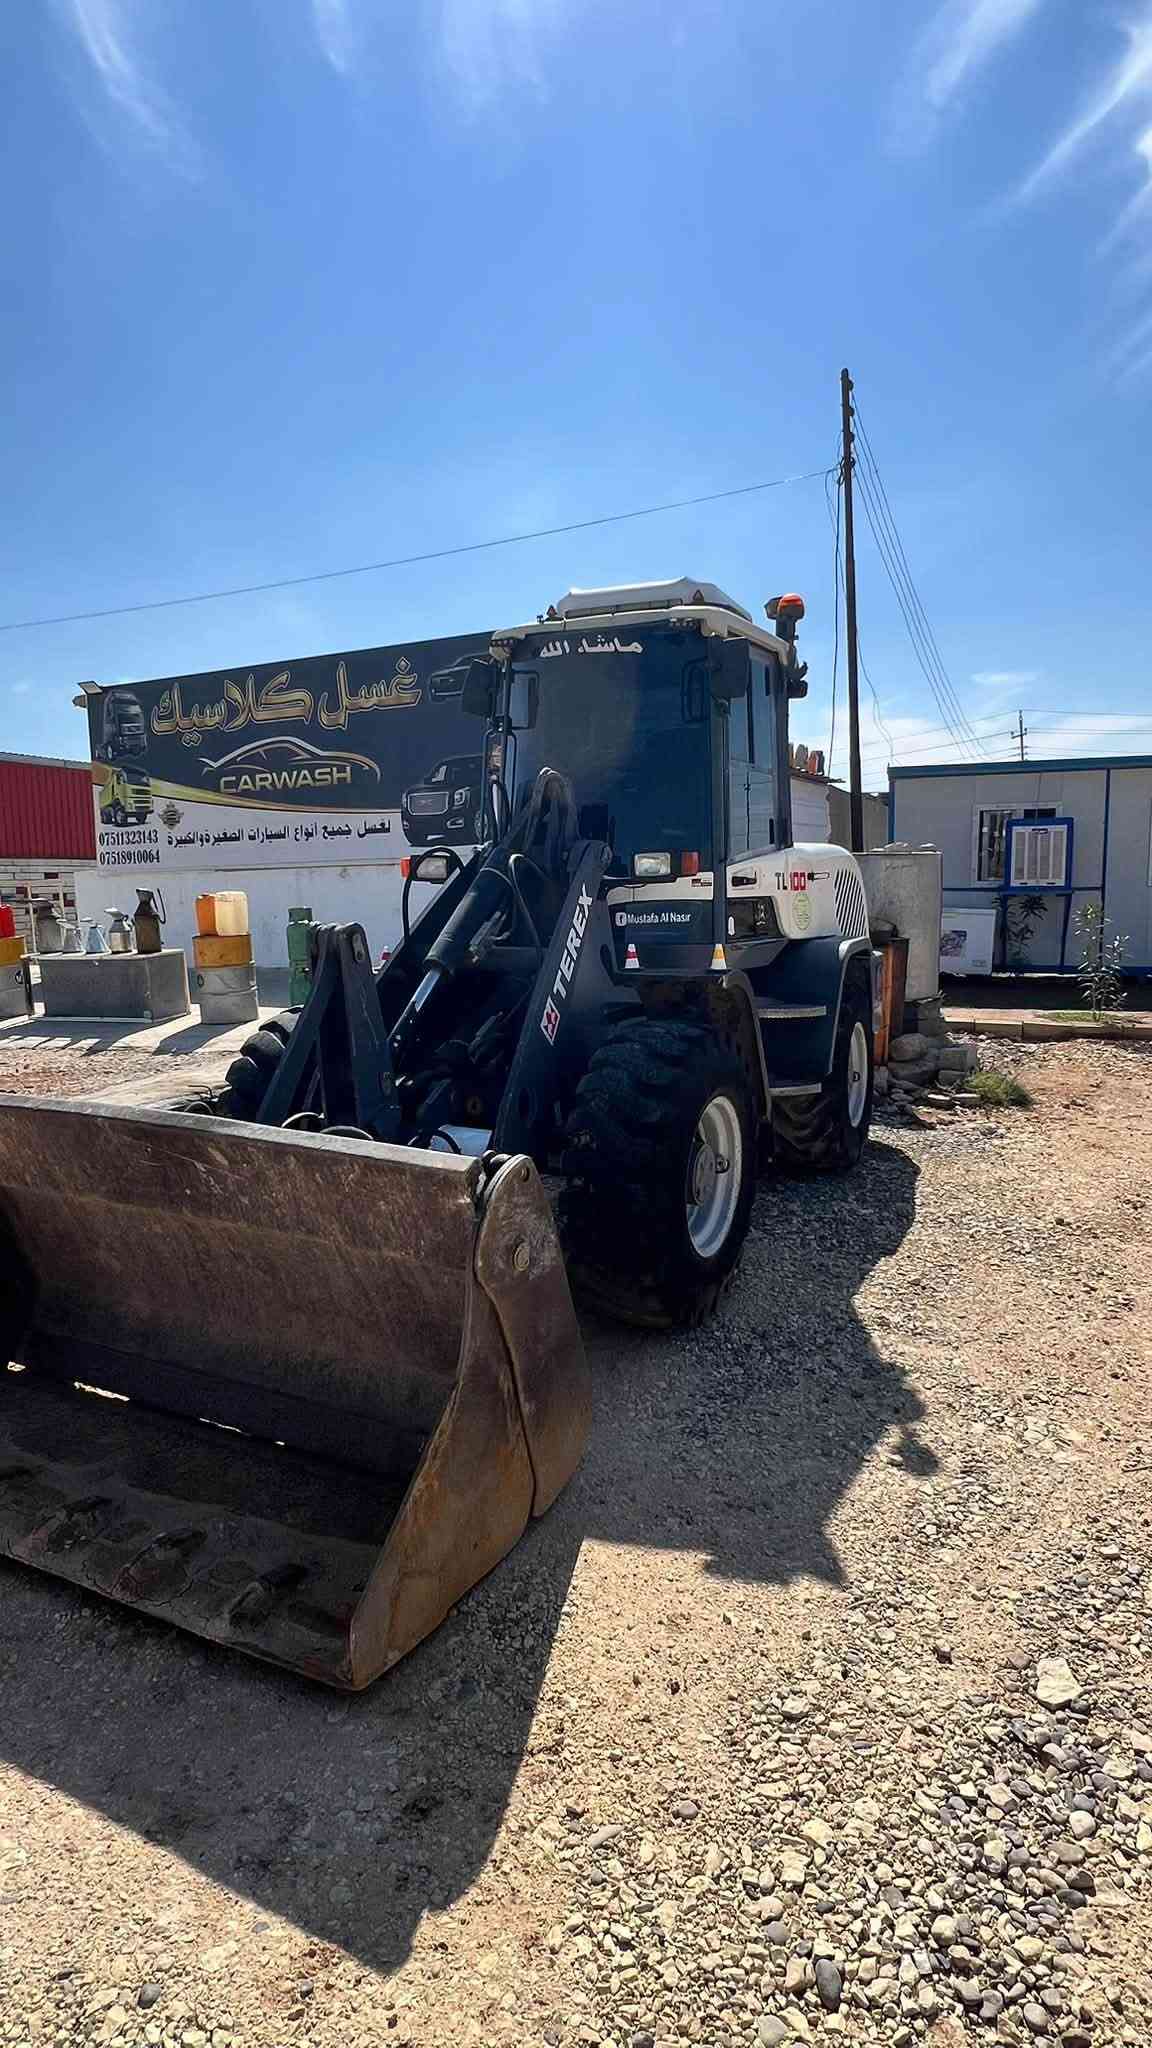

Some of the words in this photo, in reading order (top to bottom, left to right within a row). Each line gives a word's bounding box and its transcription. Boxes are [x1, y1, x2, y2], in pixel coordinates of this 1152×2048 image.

[540, 640, 570, 658] الله
[578, 635, 643, 653] ماشاء
[318, 657, 422, 731] غسل
[150, 672, 314, 747] كلاسيك
[219, 766, 352, 793] CARWASH
[247, 825, 290, 844] السيارات
[321, 824, 352, 840] جميع
[357, 818, 391, 838] لغسل
[99, 829, 159, 847] 07511323143
[99, 849, 160, 865] 07518910064
[774, 872, 788, 890] TL
[789, 872, 807, 891] 100
[627, 912, 660, 925] Mustafa
[660, 912, 669, 923] Al
[553, 883, 593, 999] TEREX
